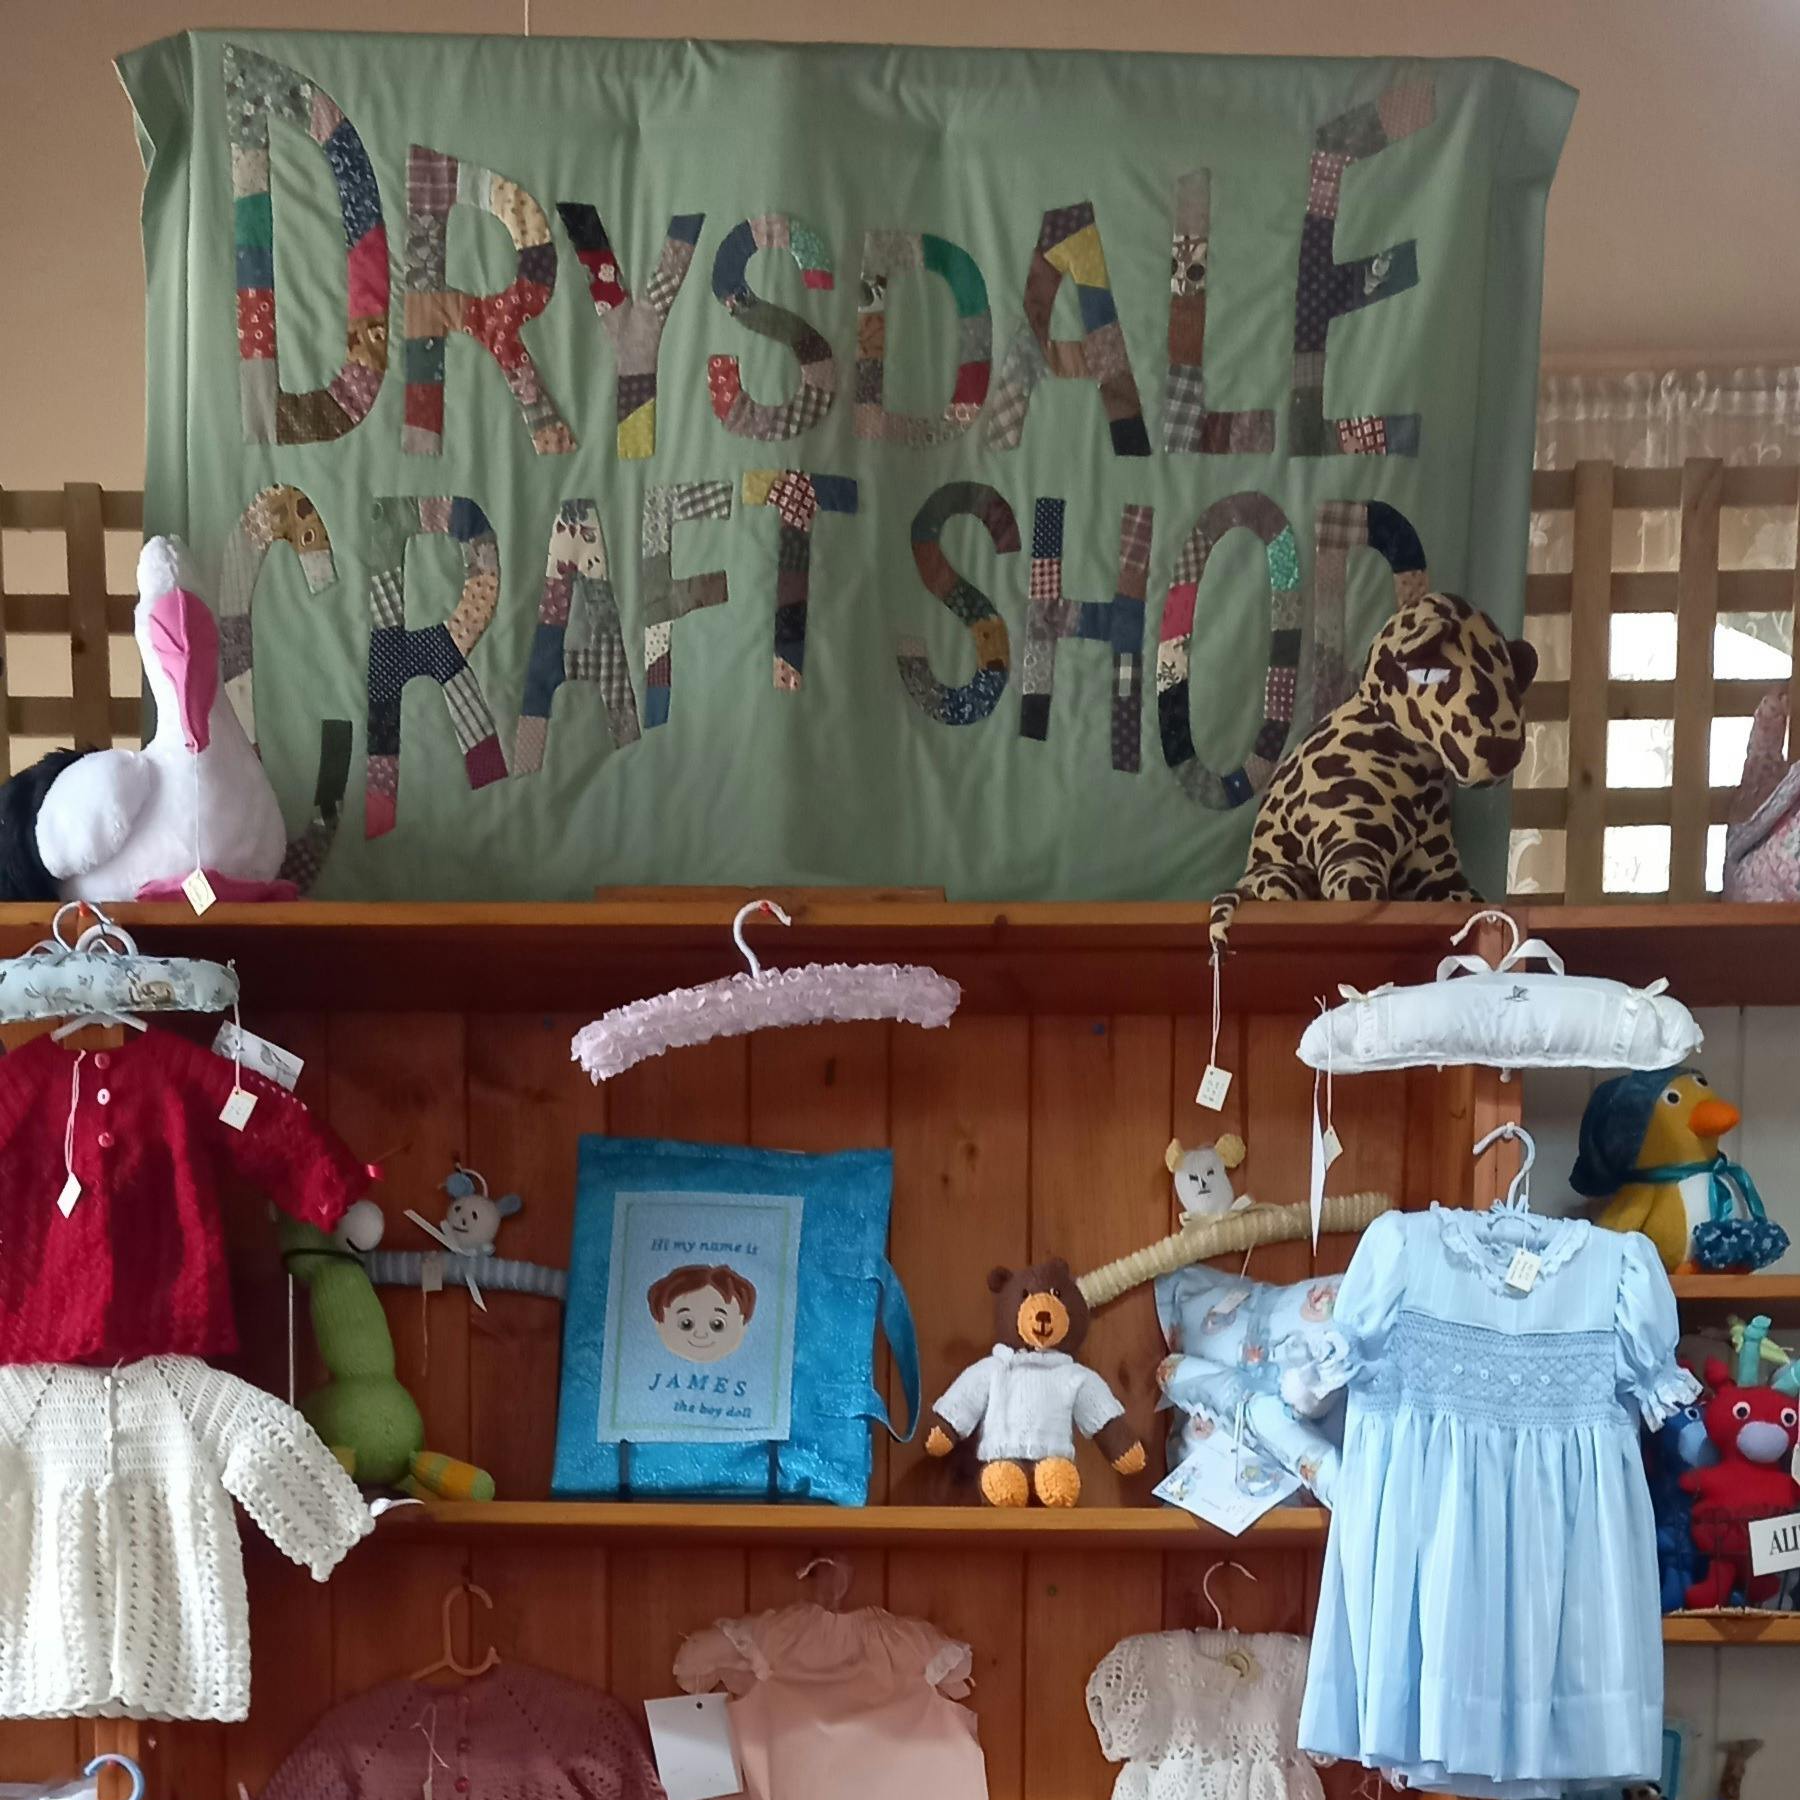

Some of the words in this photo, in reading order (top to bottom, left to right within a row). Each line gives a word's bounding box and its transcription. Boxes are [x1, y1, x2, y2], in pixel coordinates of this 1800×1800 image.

[224, 43, 1436, 460] DRYSDALE
[219, 469, 858, 897] CRAFT
[651, 1238, 670, 1252] Hi
[673, 1240, 697, 1253] my
[700, 1241, 742, 1253] name
[648, 1373, 747, 1397] JAMES
[673, 1400, 695, 1413] the
[698, 1402, 722, 1418] boy
[725, 1406, 752, 1418] doll
[1769, 1523, 1800, 1556] ALI
